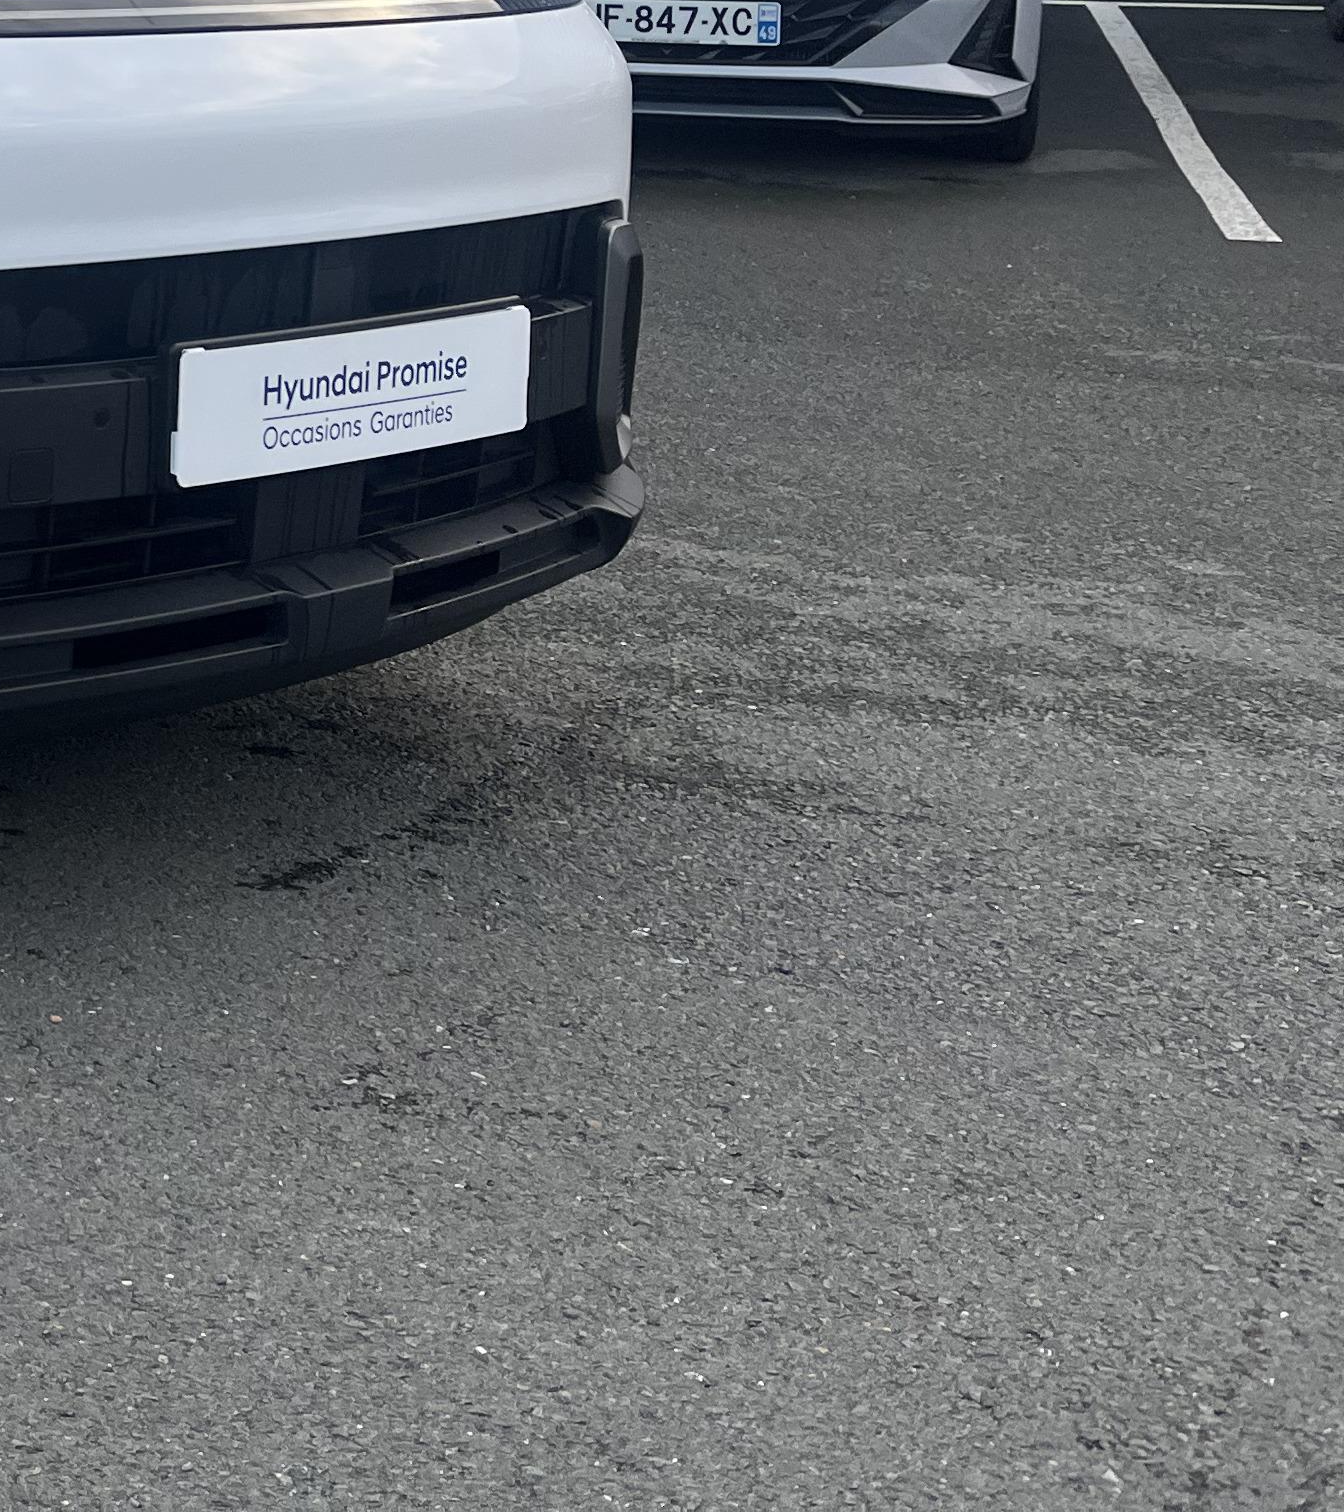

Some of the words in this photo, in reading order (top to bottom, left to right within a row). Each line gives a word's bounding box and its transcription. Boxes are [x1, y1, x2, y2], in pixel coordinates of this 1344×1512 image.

[263, 360, 370, 410] Hyundai
[377, 350, 467, 390] Promise
[263, 416, 362, 450] Occasions
[370, 400, 454, 434] Garanties
